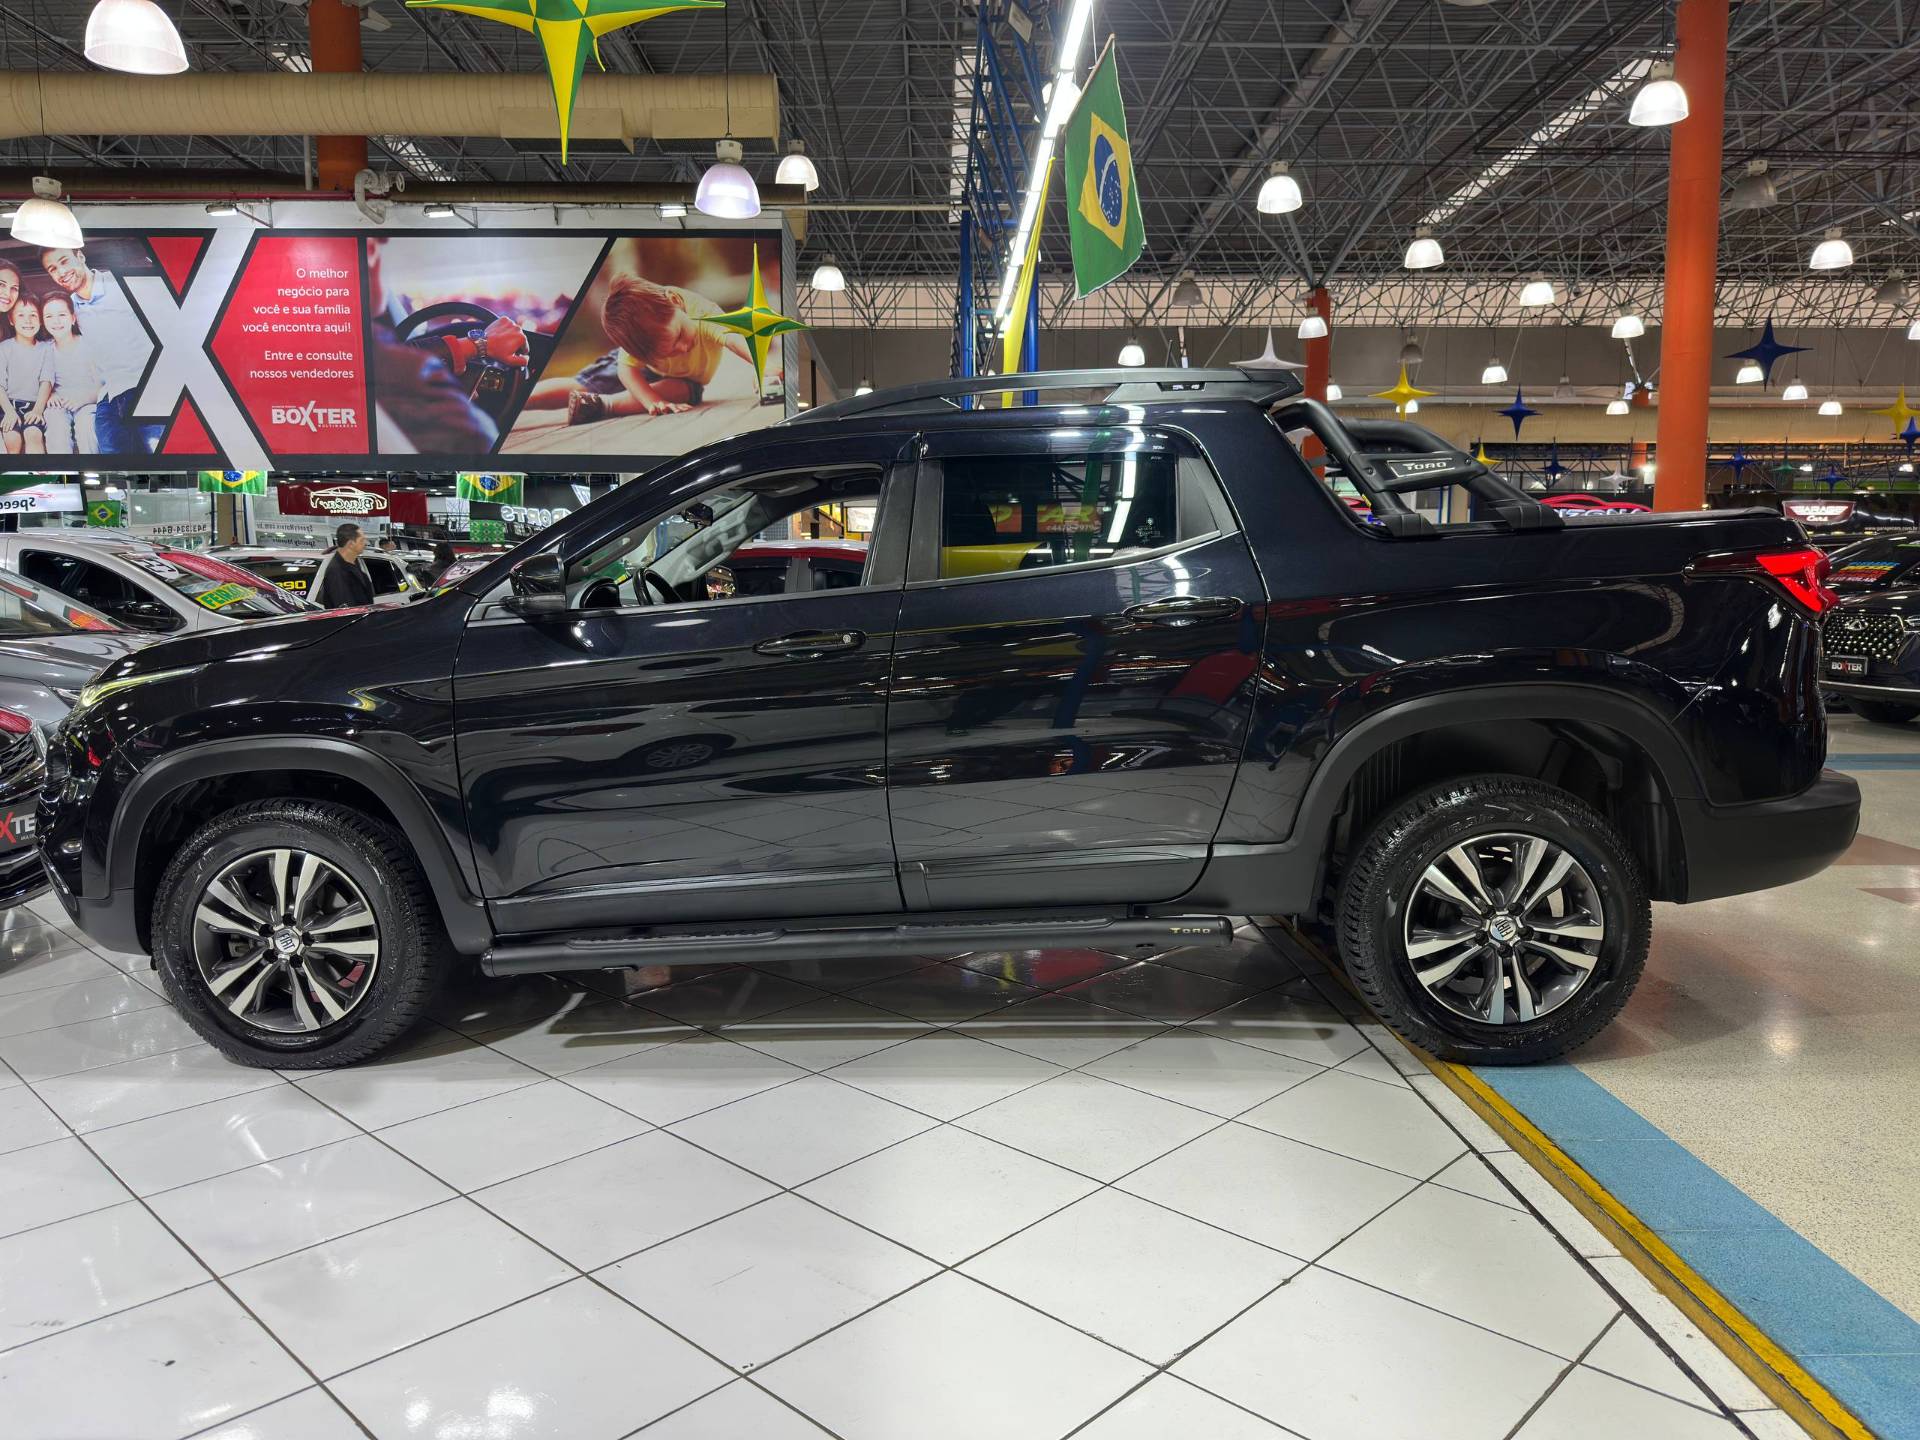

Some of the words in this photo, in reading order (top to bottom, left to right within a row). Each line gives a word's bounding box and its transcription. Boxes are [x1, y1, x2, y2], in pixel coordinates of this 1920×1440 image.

[296, 268, 306, 279] O
[309, 268, 349, 279] melhor
[277, 286, 323, 299] negócio
[326, 287, 350, 299] para
[253, 304, 281, 314] você
[283, 306, 290, 314] e
[293, 306, 312, 314] sua
[314, 304, 351, 315] família
[242, 322, 269, 333] você
[272, 322, 322, 333] encontra
[324, 322, 352, 335] aqui!
[264, 350, 294, 361] Entre
[296, 352, 304, 361] e
[306, 350, 353, 361] consulte
[250, 369, 288, 379] nossos
[290, 368, 354, 379] vendedores
[271, 400, 358, 433] BOXTER
[1402, 461, 1447, 471] TORO
[1831, 661, 1862, 674] BOXTER
[278, 932, 296, 950] FIAT
